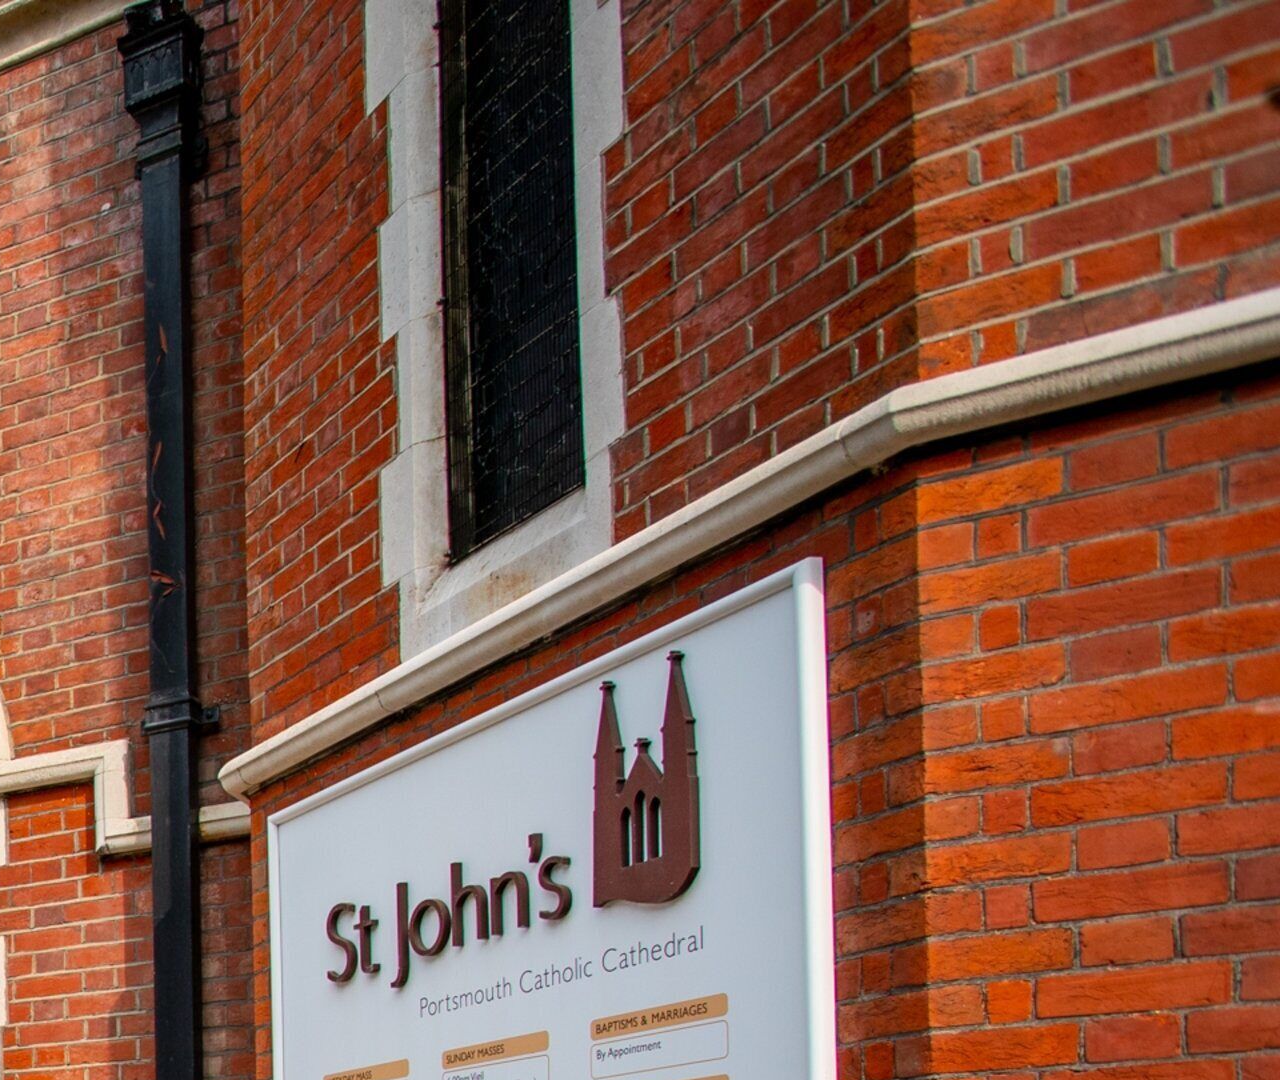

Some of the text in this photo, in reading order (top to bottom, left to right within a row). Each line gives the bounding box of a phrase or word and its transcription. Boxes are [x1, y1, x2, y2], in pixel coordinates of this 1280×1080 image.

[326, 833, 572, 988] St John's
[419, 925, 704, 1018] Portsmouth Catholic Cathedral
[595, 1002, 708, 1034] BAPTISMS & MARRIAGES
[446, 1044, 505, 1065] SUNDAY MASSES
[596, 1040, 662, 1062] By Appointment
[356, 1070, 373, 1080] MASS
